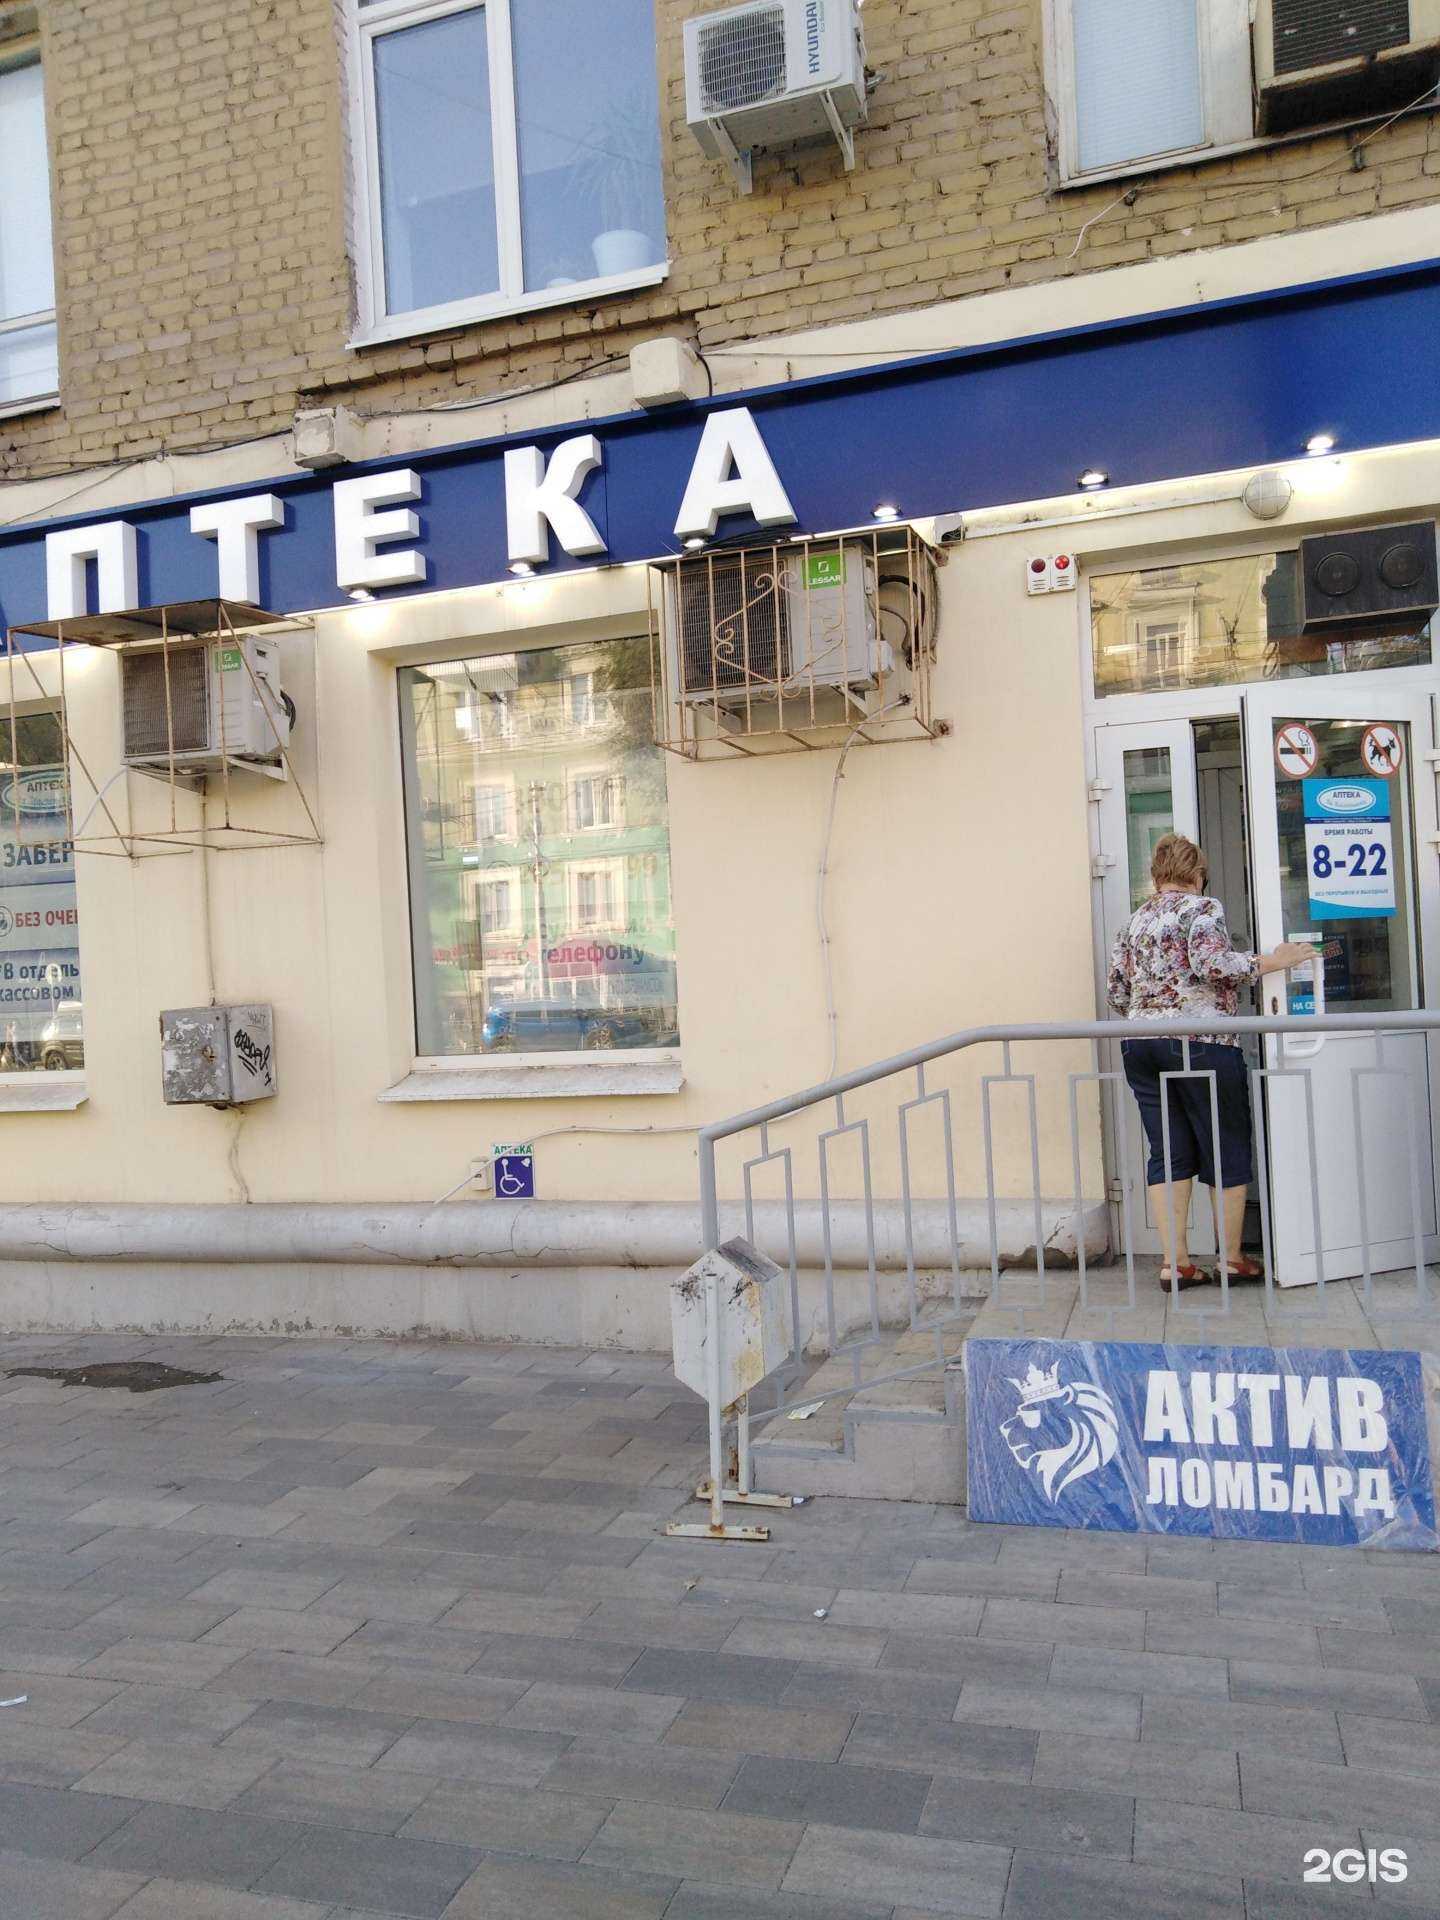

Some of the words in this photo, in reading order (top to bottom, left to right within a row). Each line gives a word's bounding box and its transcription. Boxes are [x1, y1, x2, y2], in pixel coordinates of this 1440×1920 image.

[806, 2, 820, 73] HYUNDAI
[1333, 791, 1360, 799] АПТЕКА
[1313, 843, 1387, 879] 8-22
[15, 912, 41, 928] БЕЗ
[1143, 1369, 1389, 1453] АКТИВ
[1146, 1456, 1397, 1519] ЛОМБАРД
